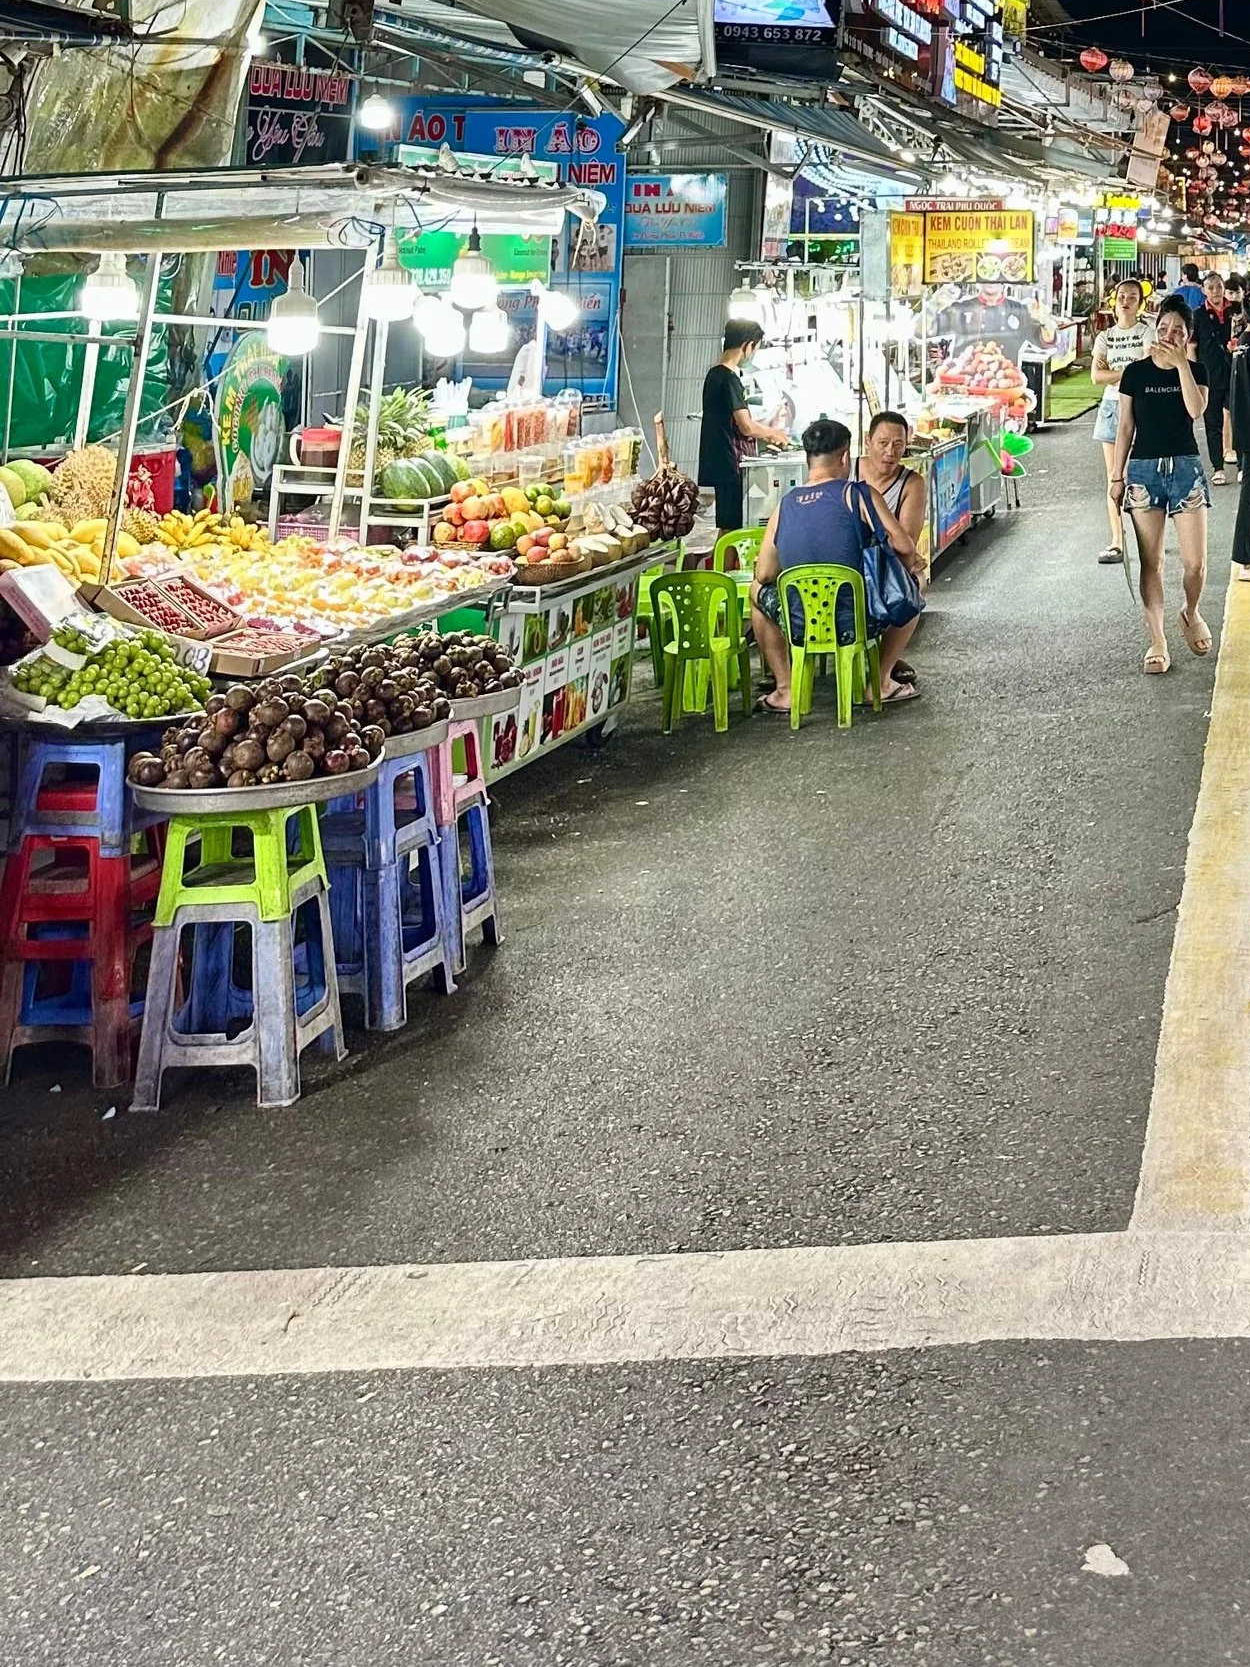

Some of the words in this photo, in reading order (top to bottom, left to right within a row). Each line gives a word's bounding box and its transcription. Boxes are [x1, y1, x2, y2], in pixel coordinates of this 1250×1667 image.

[723, 25, 759, 39] 0943
[763, 27, 790, 40] 653
[795, 29, 821, 42] 872
[407, 109, 446, 141] ÁO
[494, 126, 536, 154] IN
[547, 120, 602, 155] ÁO
[568, 159, 616, 189] NIỆM
[633, 182, 661, 197] IN
[930, 216, 951, 231] KEM
[1009, 216, 1028, 231] LAN
[928, 238, 961, 249] THAILAND
